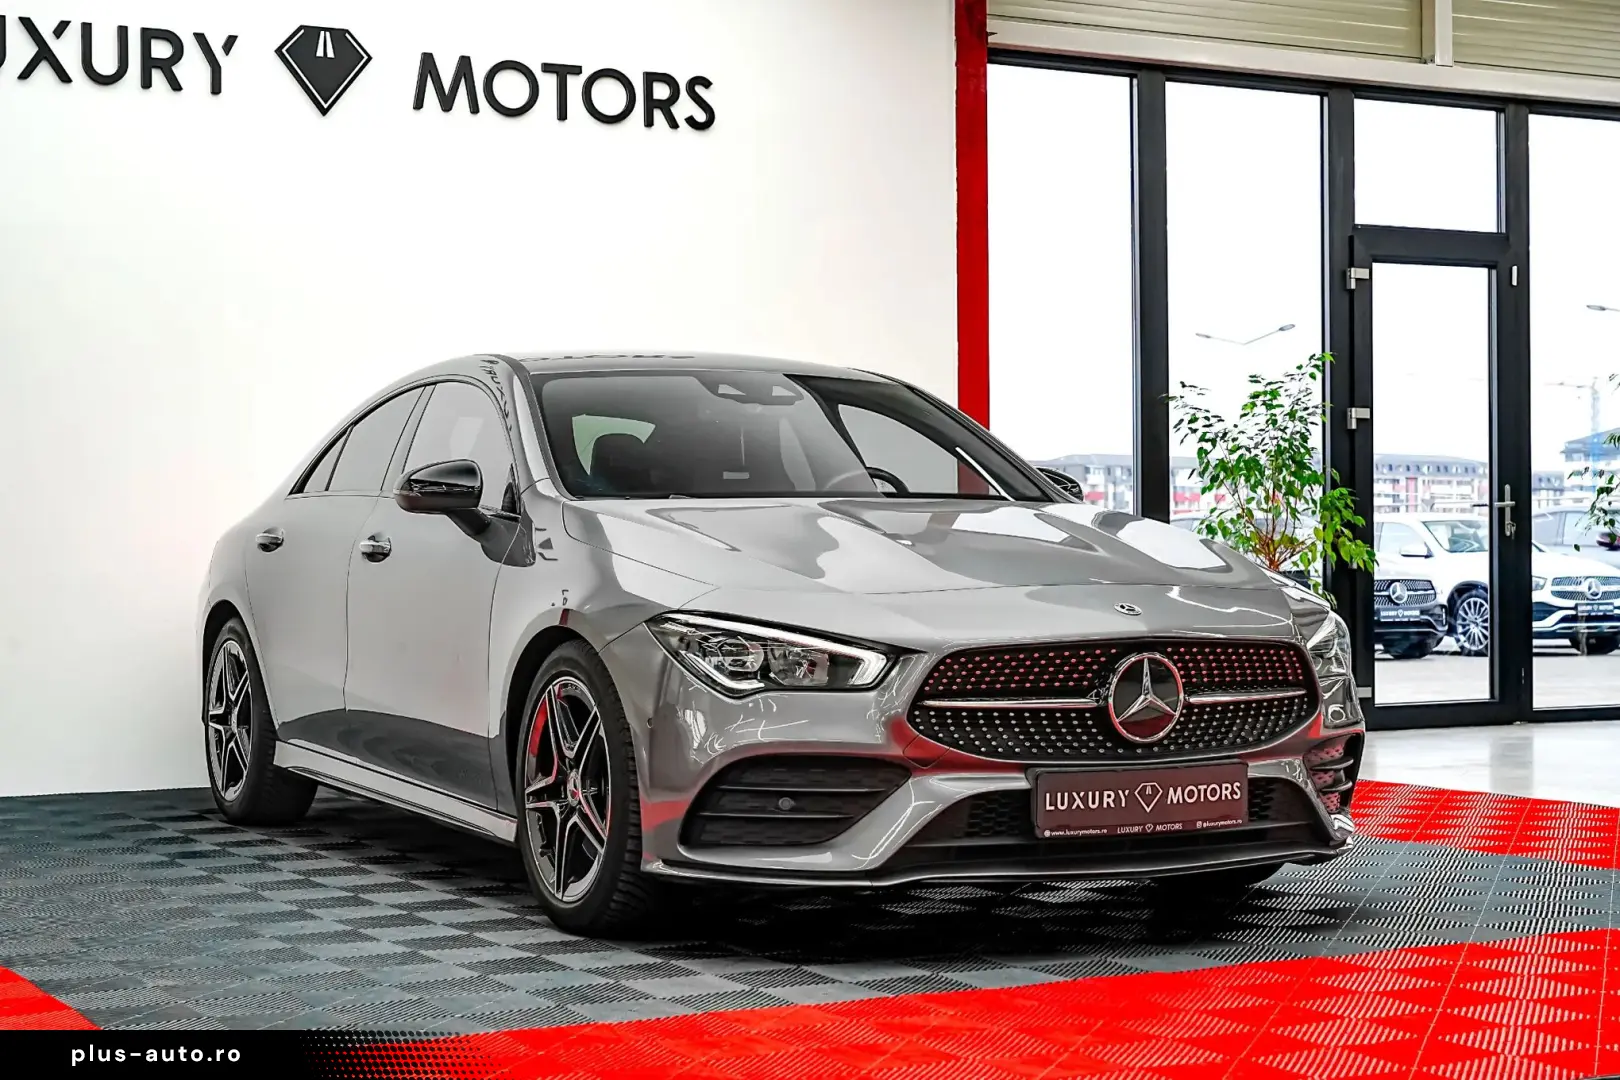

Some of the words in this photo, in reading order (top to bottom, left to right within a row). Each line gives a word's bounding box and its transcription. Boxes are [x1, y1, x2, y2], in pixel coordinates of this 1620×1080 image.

[0, 14, 239, 96] XURY
[412, 51, 716, 132] MOTORS
[1045, 790, 1129, 811] LUXURY
[1166, 782, 1241, 805] MOTORS
[1117, 825, 1143, 834] LUXURY
[1155, 822, 1183, 831] MOTORS
